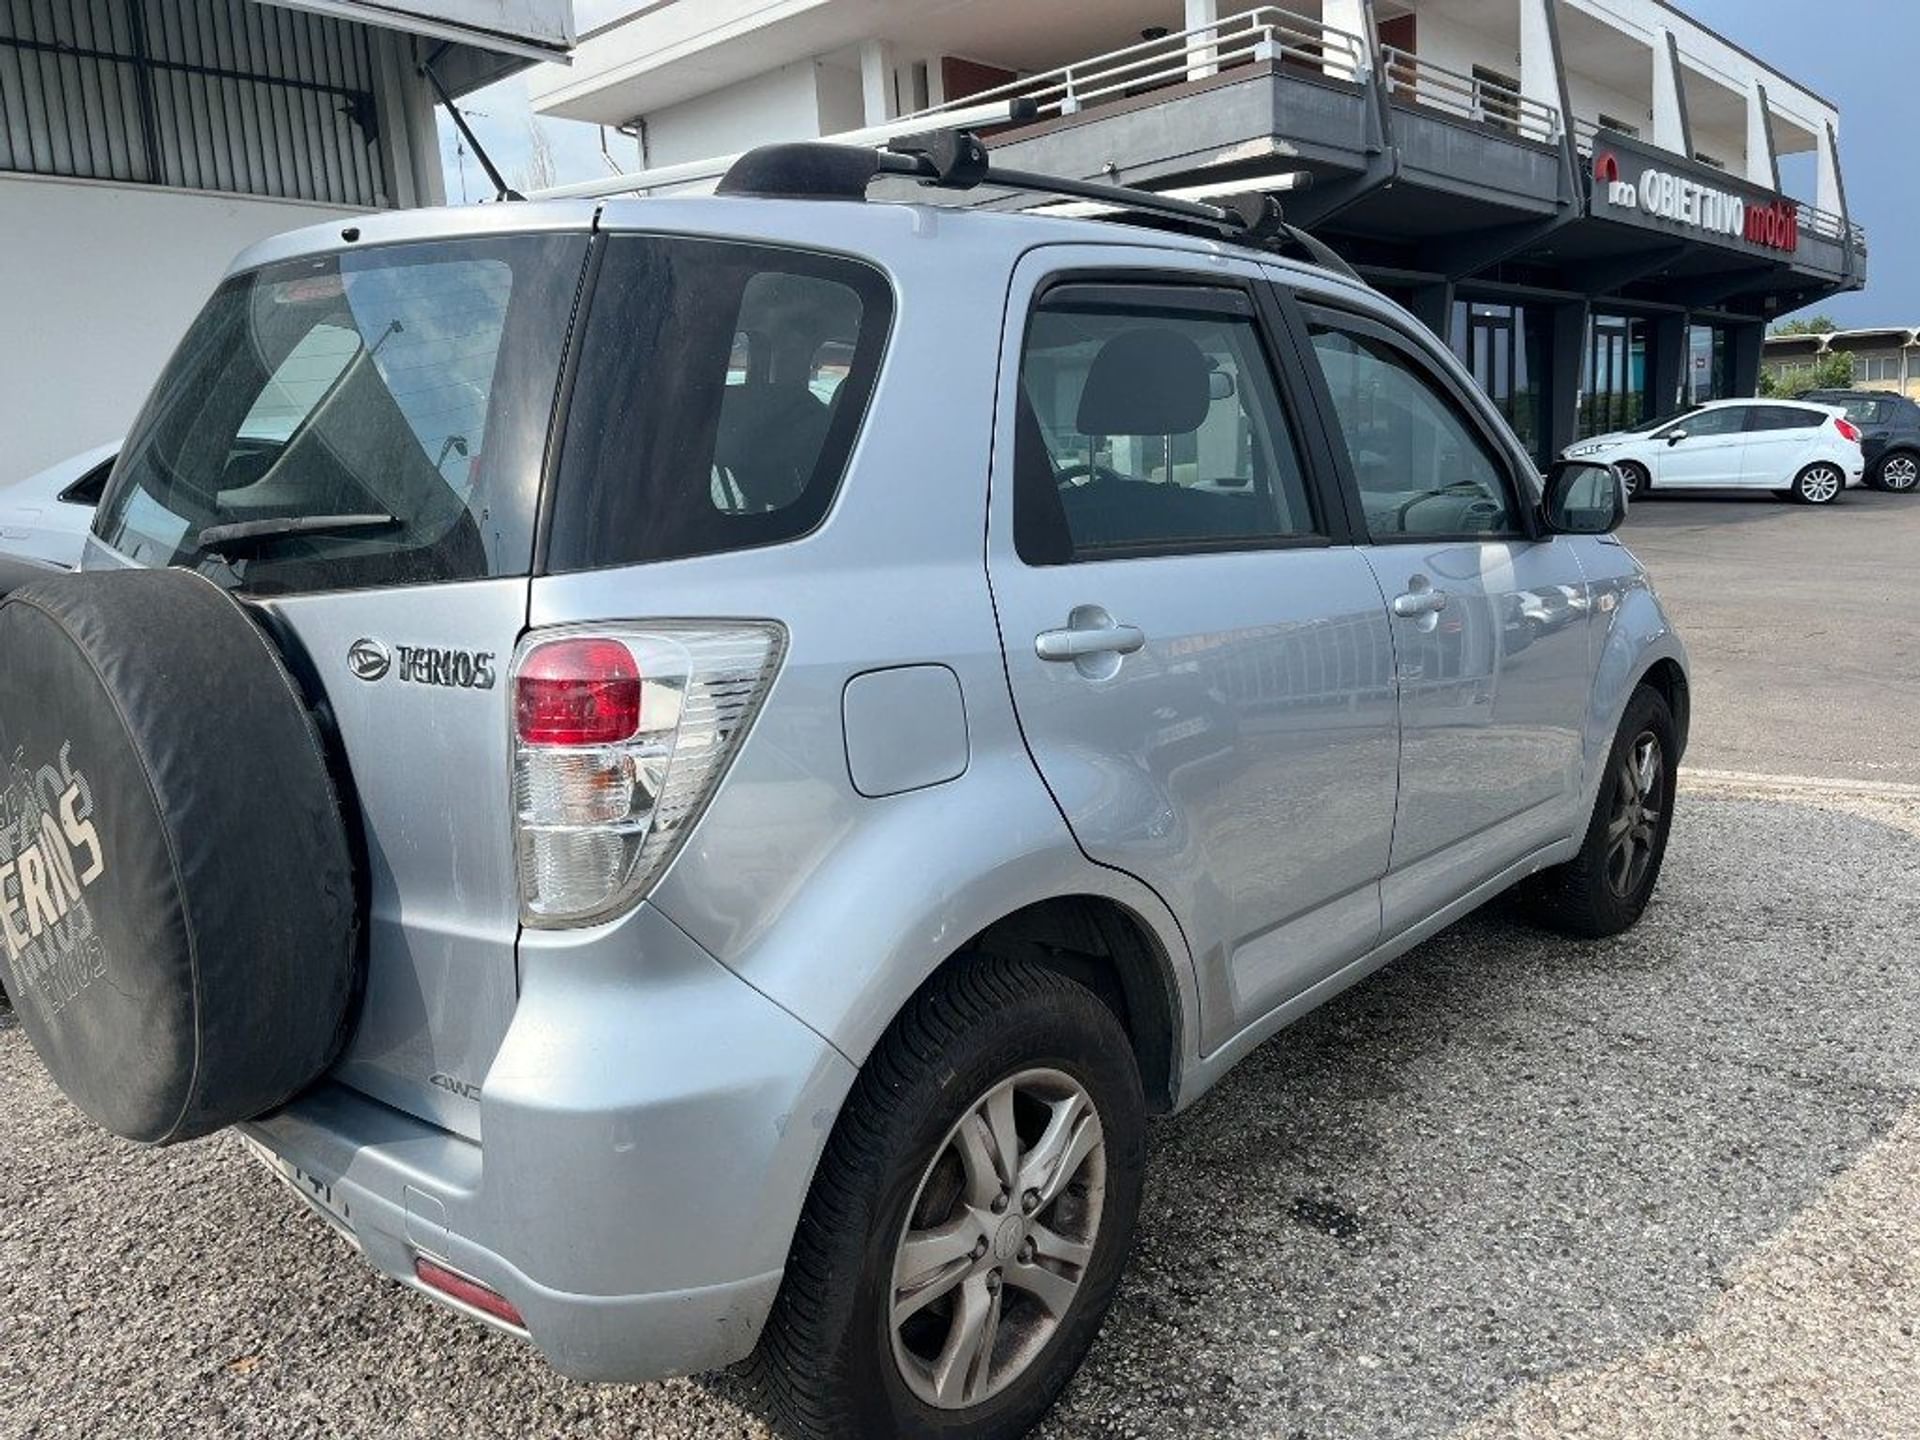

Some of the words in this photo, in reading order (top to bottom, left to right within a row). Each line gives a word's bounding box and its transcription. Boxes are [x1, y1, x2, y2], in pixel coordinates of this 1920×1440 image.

[1639, 169, 1744, 236] OBIETTIVO
[1744, 201, 1797, 253] mobili
[396, 645, 495, 689] TERIOS
[0, 783, 104, 961] ERIOS
